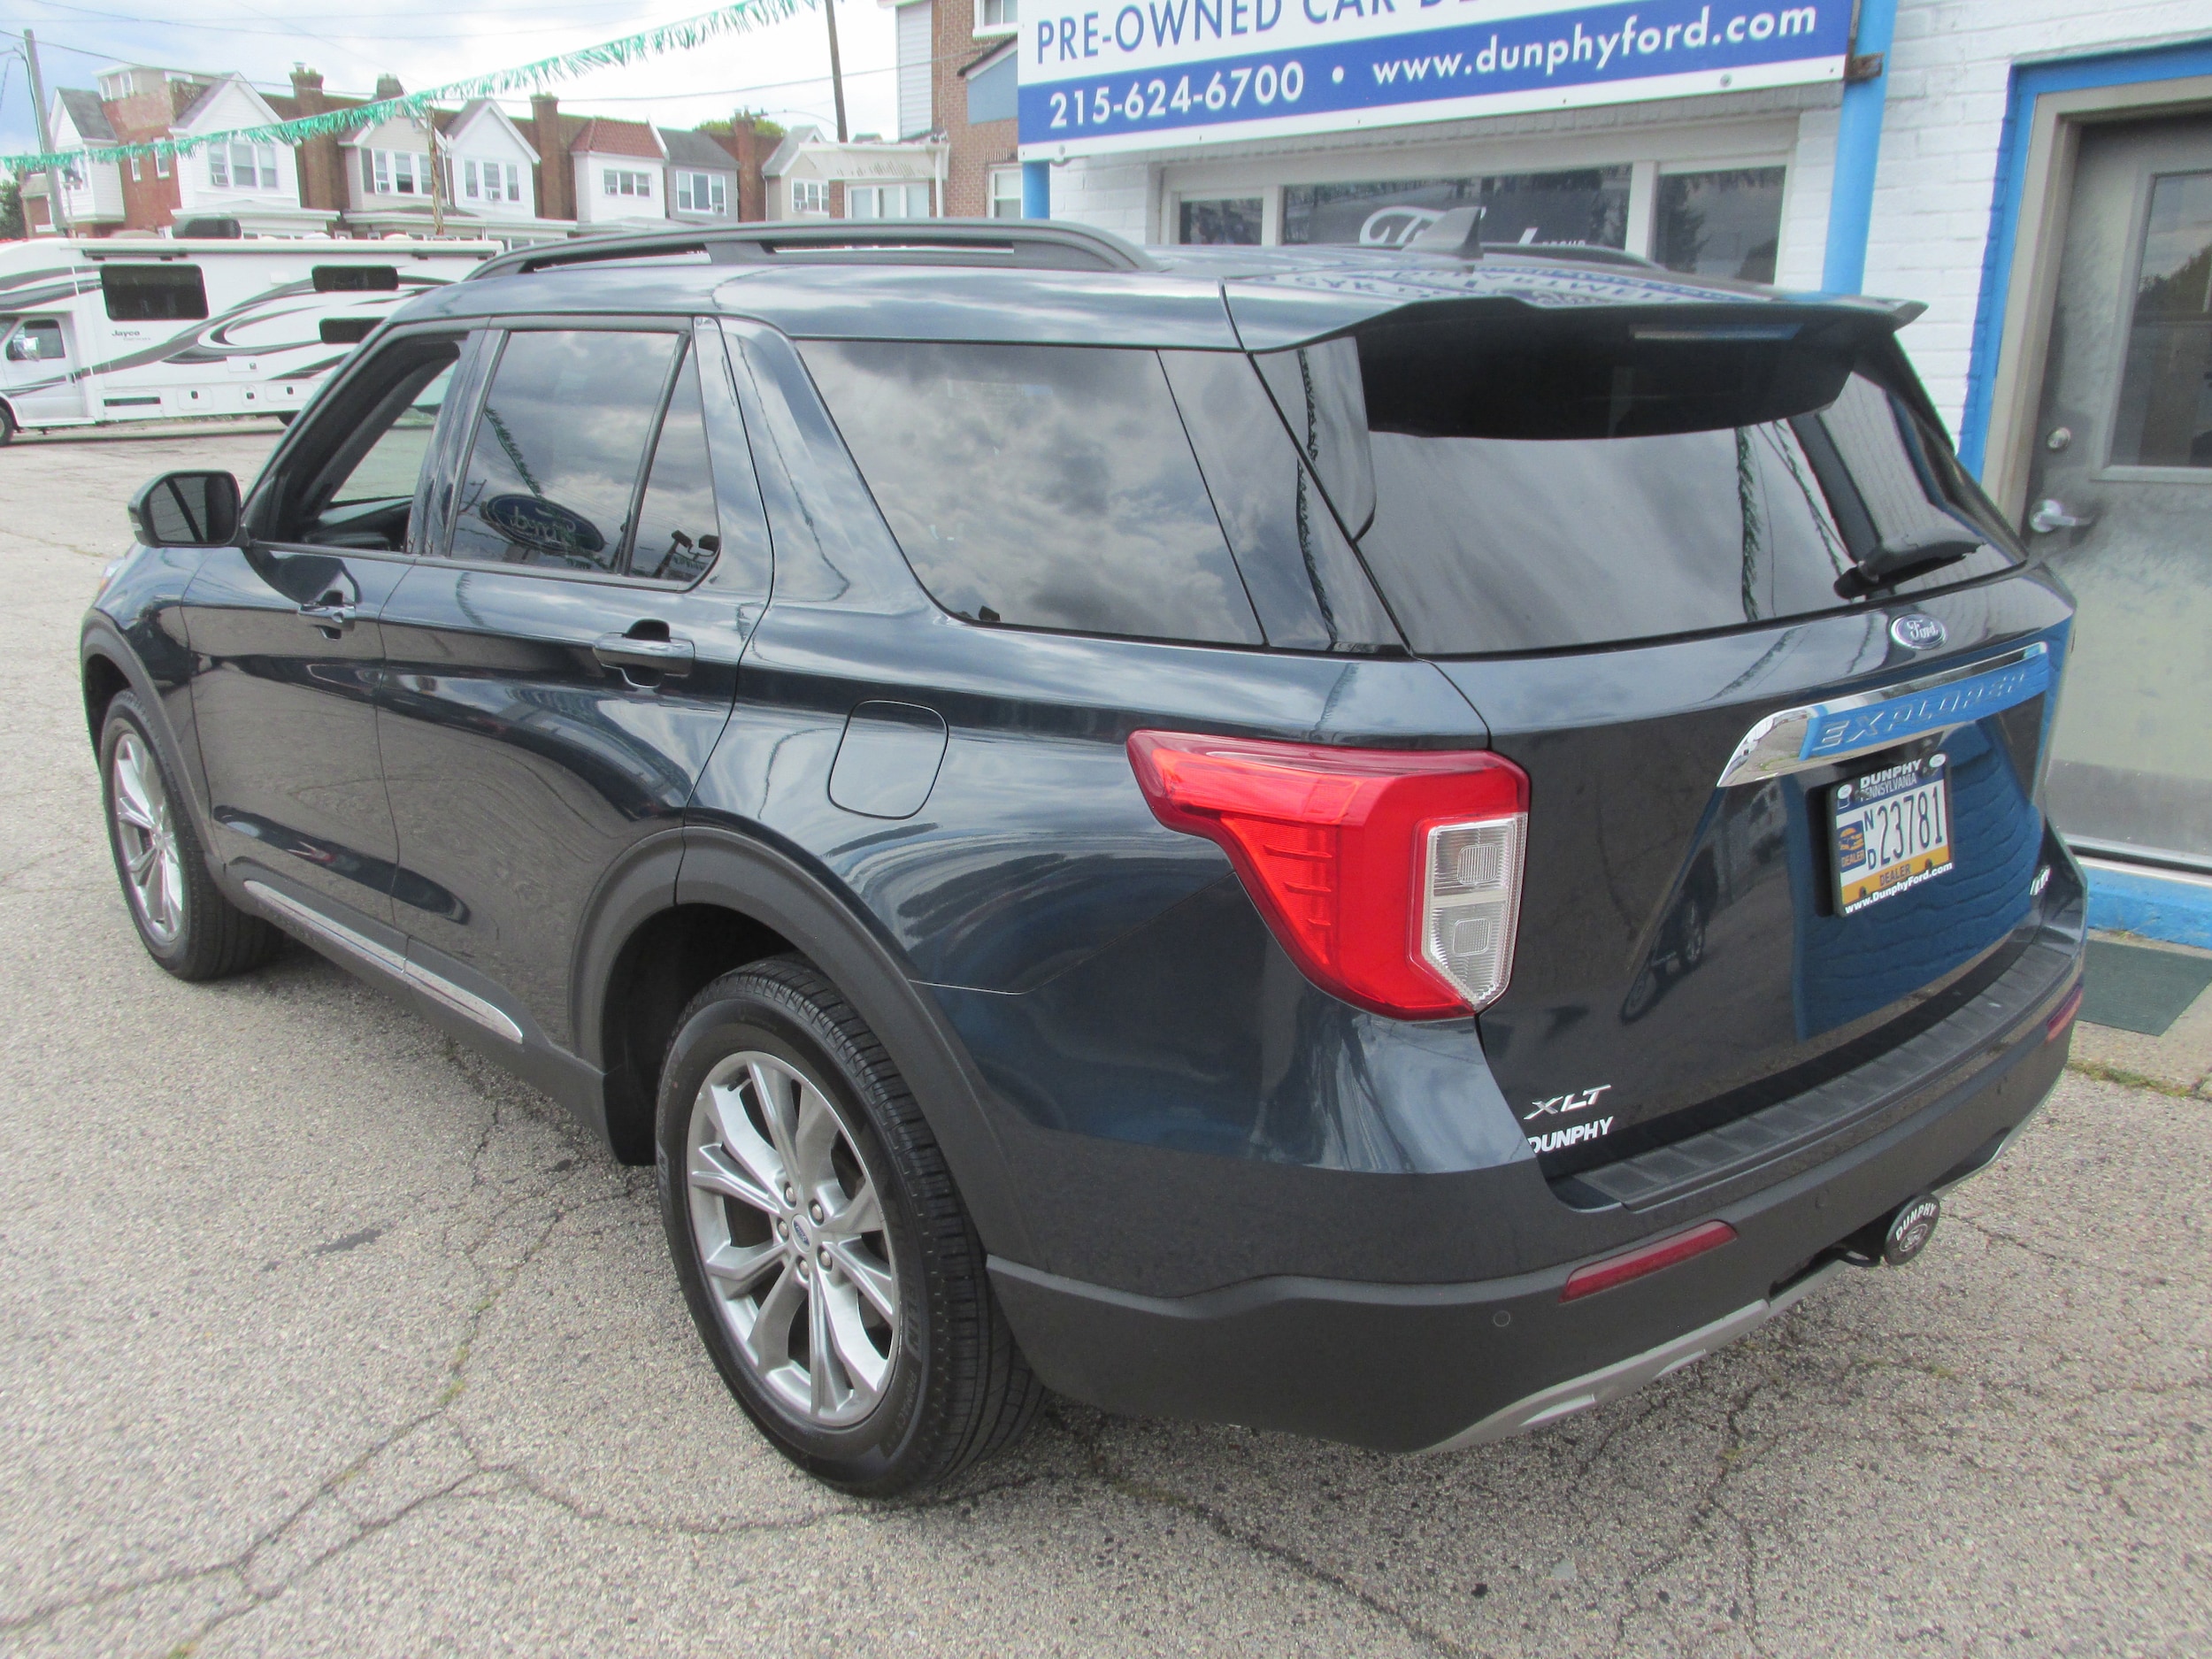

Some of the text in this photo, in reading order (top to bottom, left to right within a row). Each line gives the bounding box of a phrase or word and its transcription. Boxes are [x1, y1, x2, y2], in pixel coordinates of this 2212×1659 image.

[1037, 0, 1281, 64] PRE-OWNED
[1373, 5, 1816, 85] www.dunphyford.com
[1050, 61, 1304, 128] 215-624-6700
[1906, 619, 1939, 641] Ford
[1860, 758, 1923, 789] DUNPHY
[1877, 786, 1943, 868] 23781
[1841, 849, 1865, 867] DEALER
[1879, 864, 1911, 887] DEALER
[1845, 862, 1953, 914] www.DunphyFord.com
[1524, 1084, 1611, 1119] XLT
[1527, 1116, 1614, 1154] DUNPHY
[1895, 1202, 1936, 1241] DUNPHY
